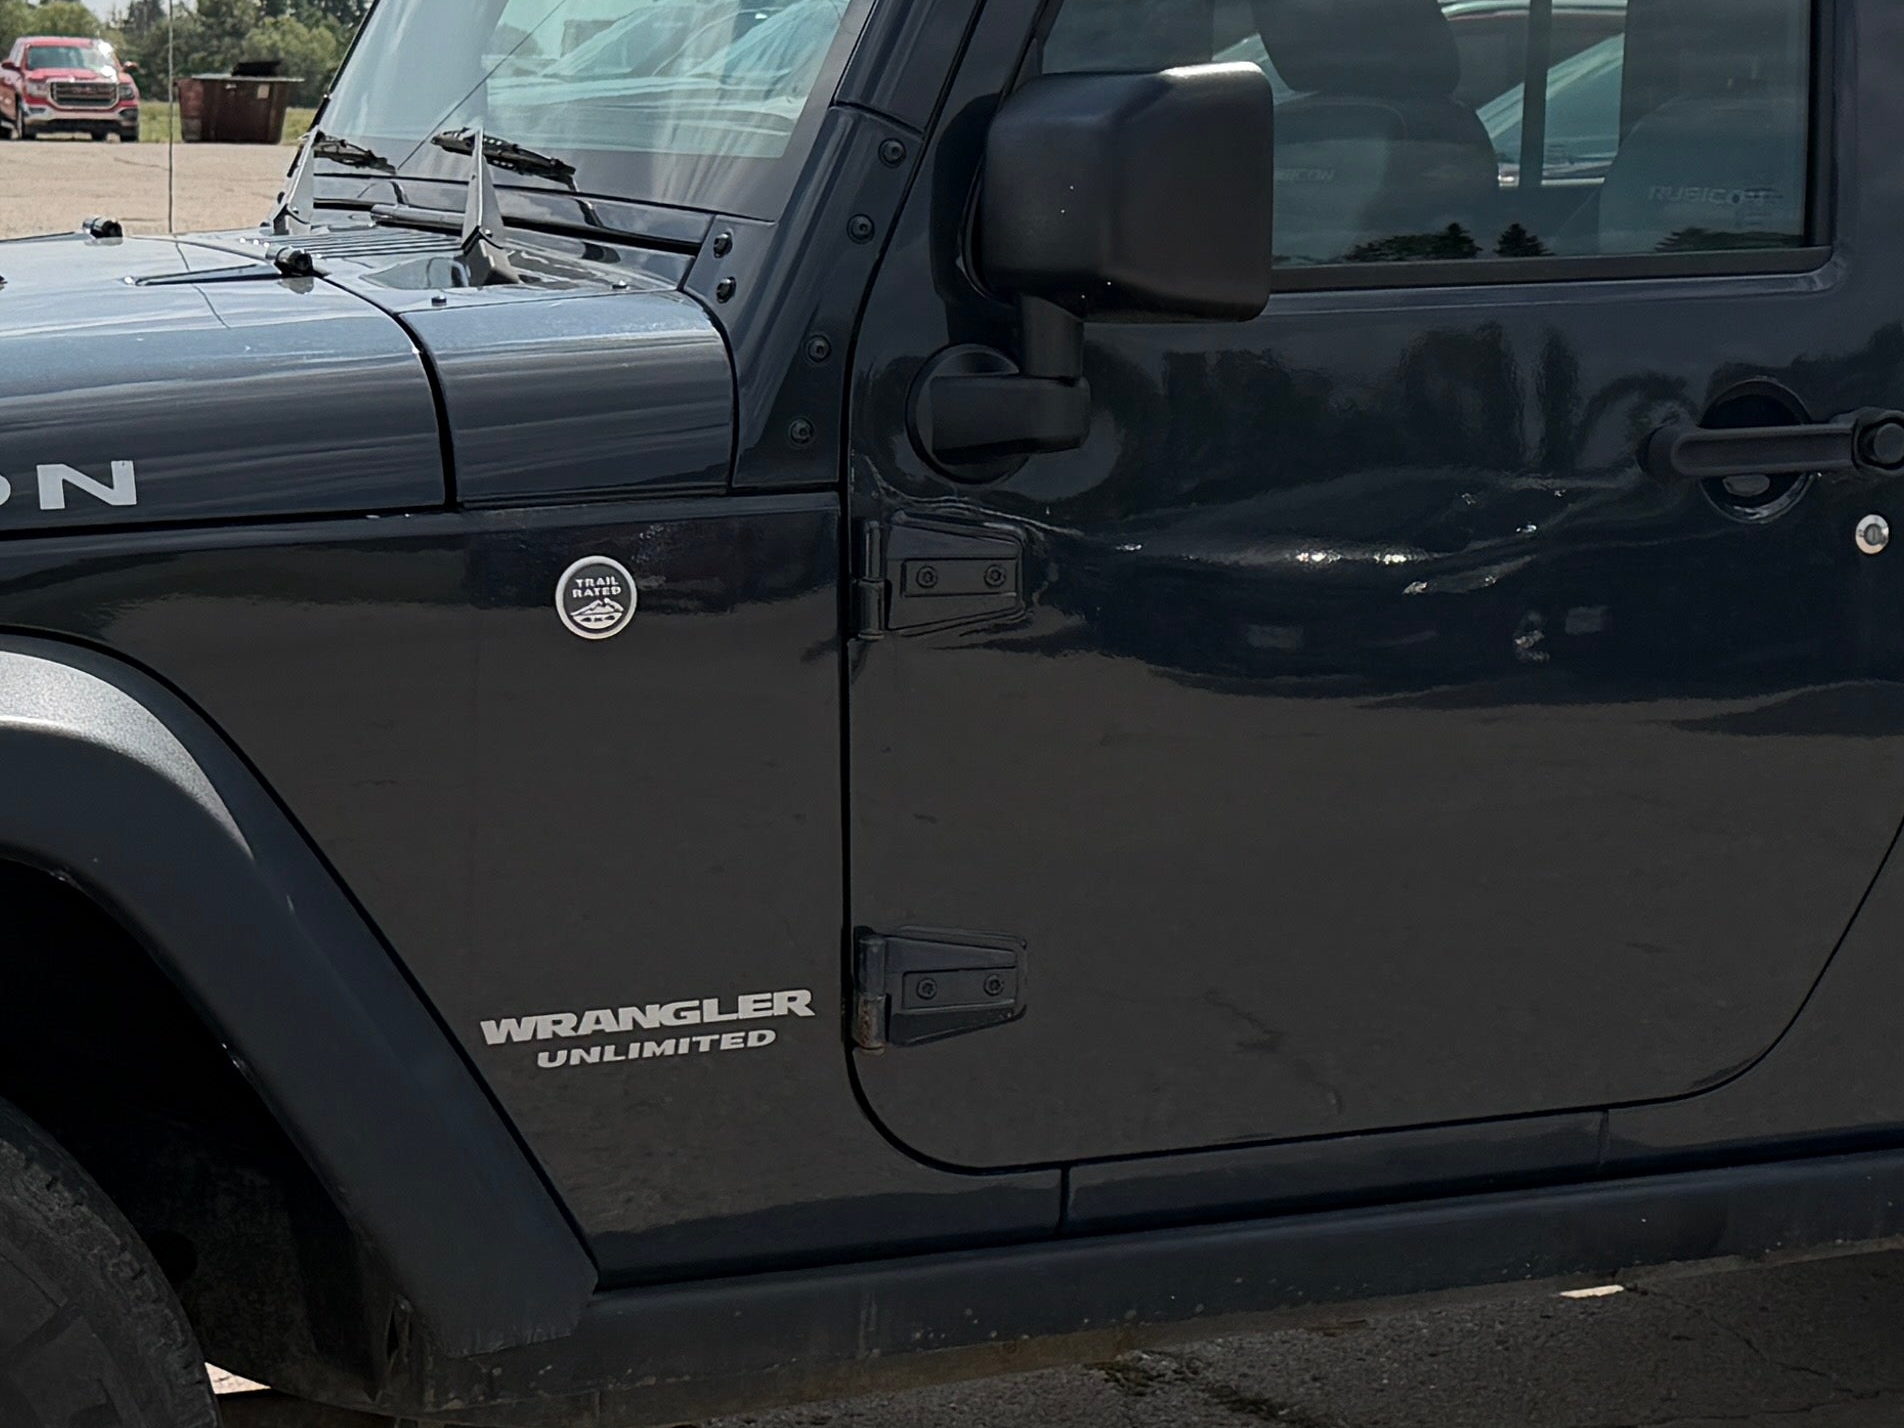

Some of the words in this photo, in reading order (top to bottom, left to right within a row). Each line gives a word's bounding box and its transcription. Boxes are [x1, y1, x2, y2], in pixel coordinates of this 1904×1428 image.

[571, 585, 623, 599] RATED
[575, 575, 620, 589] TRAIL
[479, 988, 817, 1046] WRANGLER
[536, 1028, 778, 1069] UNLIMITED
